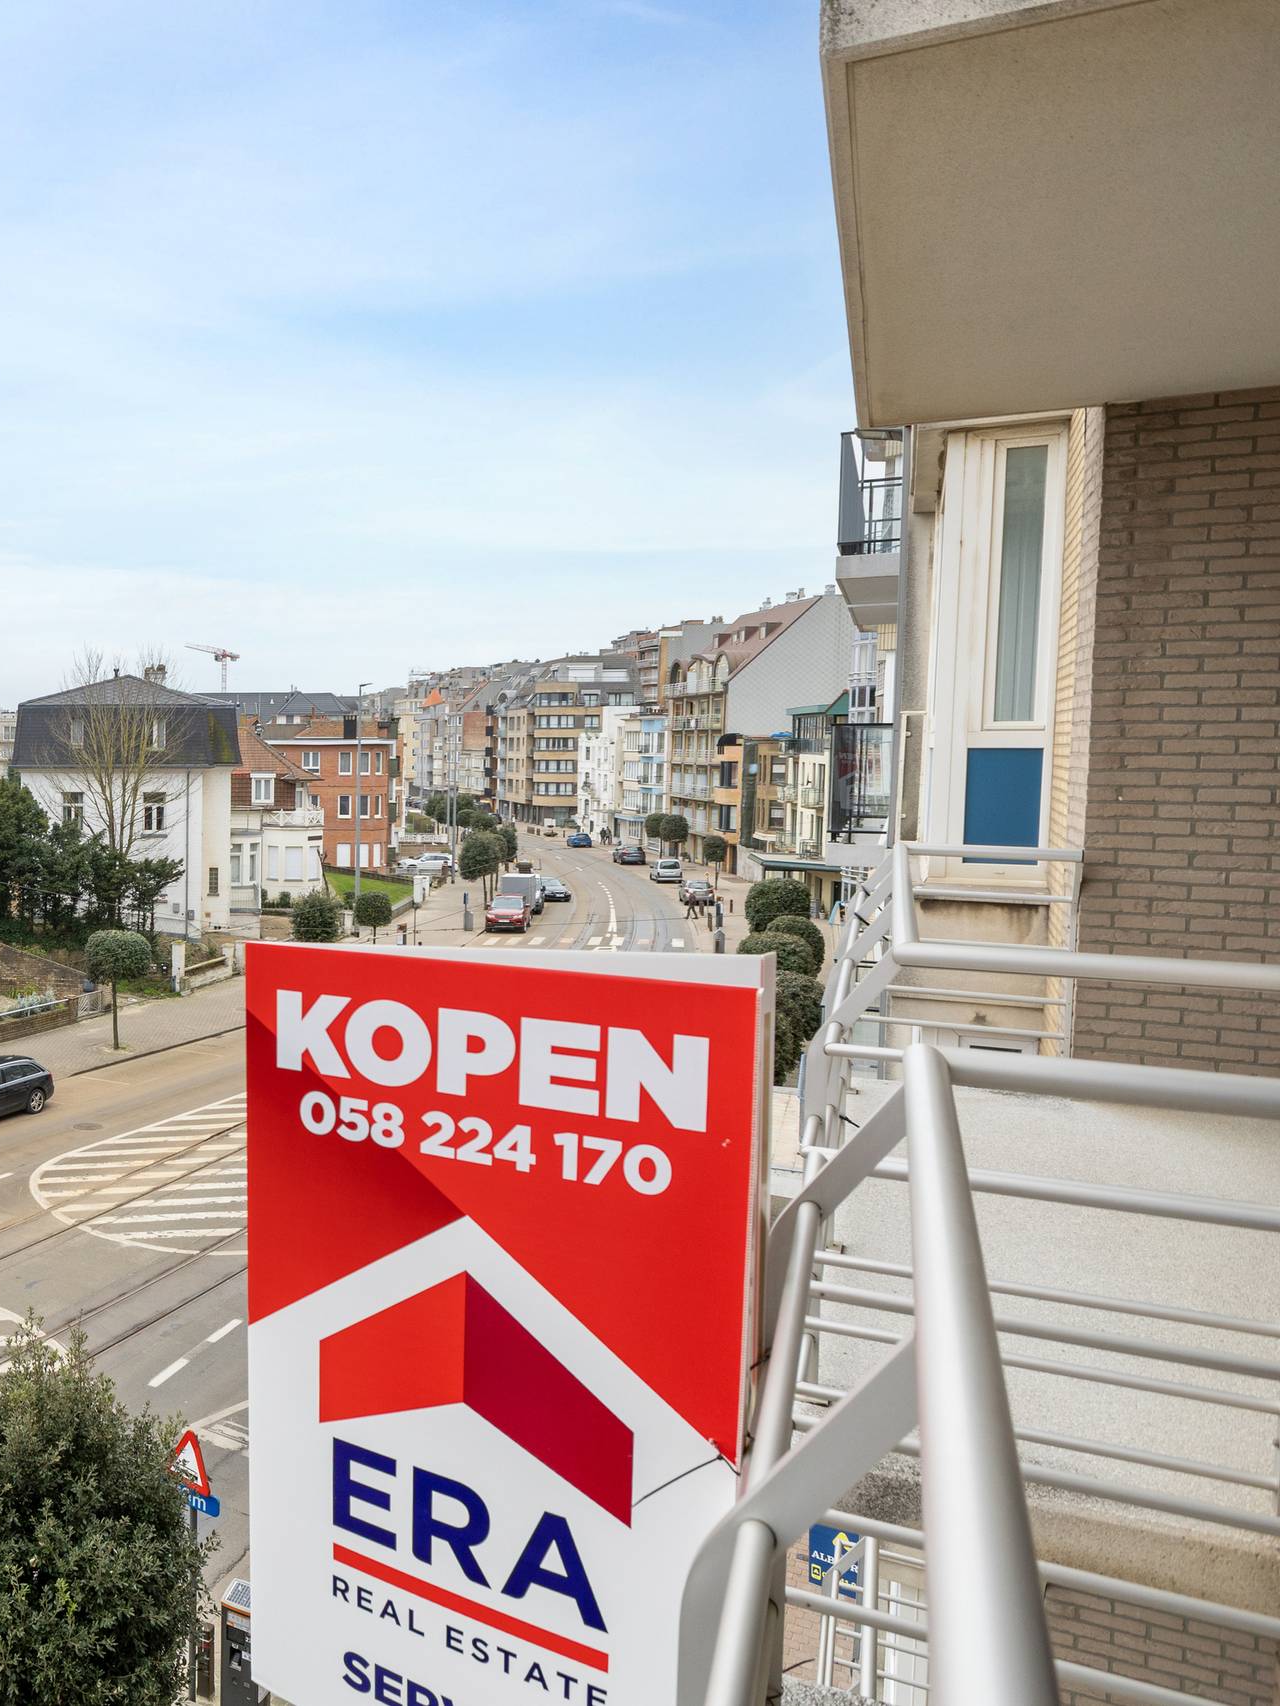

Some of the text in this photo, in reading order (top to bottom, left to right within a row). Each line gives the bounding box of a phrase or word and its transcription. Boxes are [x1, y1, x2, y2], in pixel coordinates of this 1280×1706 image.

[276, 989, 710, 1133] KOPEN
[299, 1091, 672, 1196] 058 224 170
[332, 1436, 609, 1635] ERA
[332, 1574, 609, 1706] REAL ESTATE
[341, 1650, 454, 1706] SER
